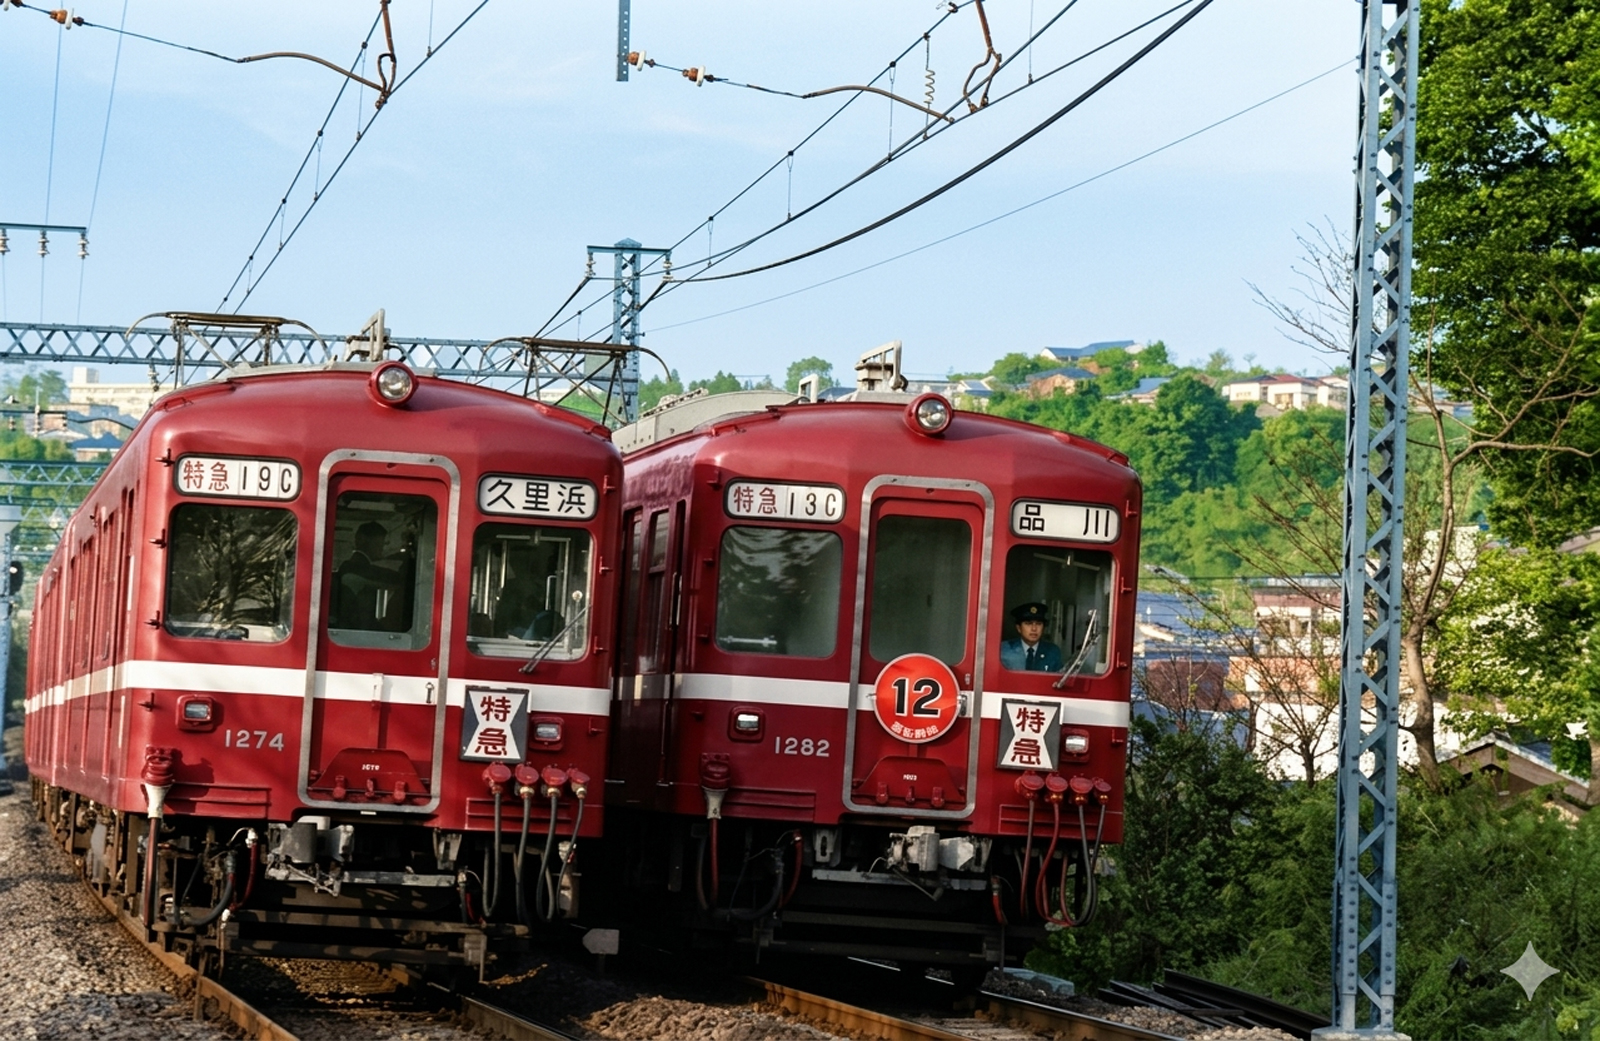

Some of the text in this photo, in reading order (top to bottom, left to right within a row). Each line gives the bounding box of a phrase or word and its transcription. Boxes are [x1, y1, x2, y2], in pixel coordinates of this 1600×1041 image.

[183, 460, 292, 493] 特急 19C
[486, 479, 586, 514] 久里浜
[733, 486, 837, 517] 特急 13C
[1019, 504, 1110, 537] 品川
[891, 677, 943, 718] 12
[225, 729, 284, 751] 1274
[474, 695, 512, 756] 特急
[1010, 707, 1046, 765] 特急
[775, 736, 830, 757] 1282
